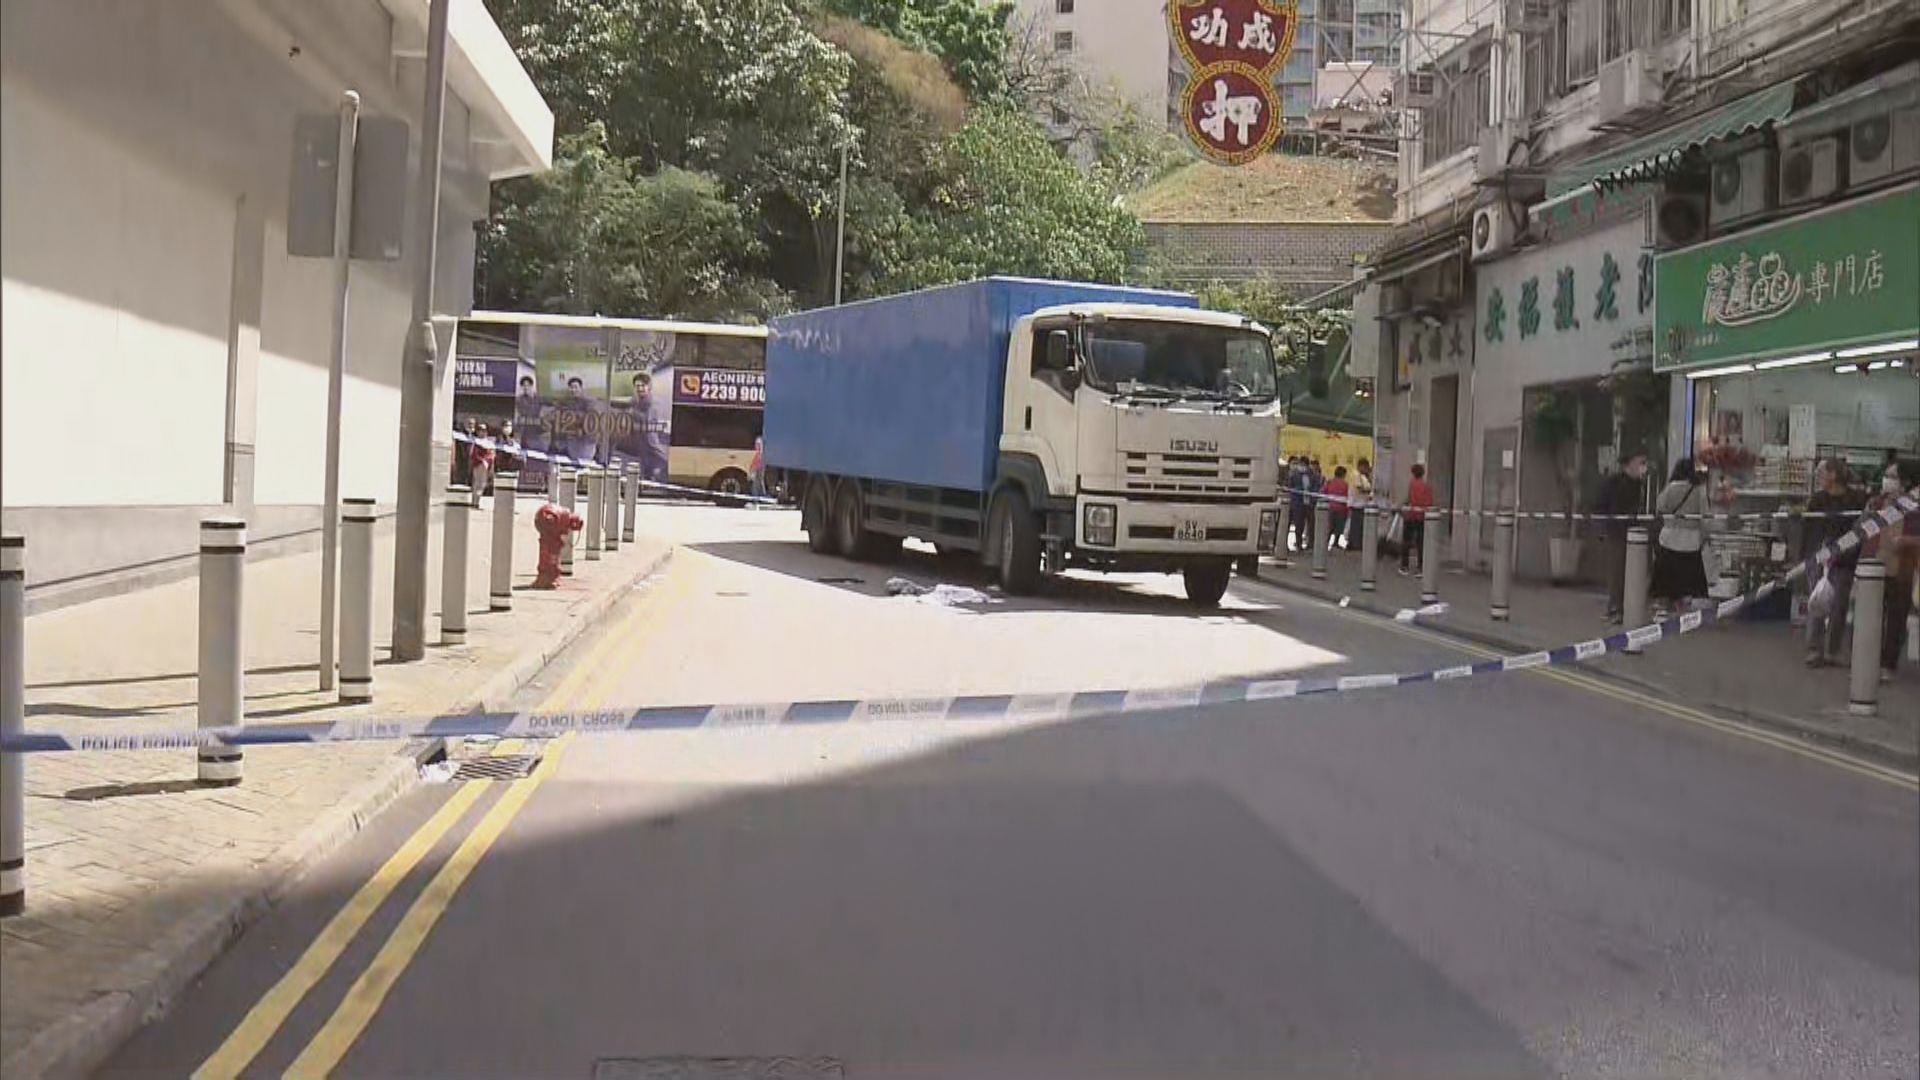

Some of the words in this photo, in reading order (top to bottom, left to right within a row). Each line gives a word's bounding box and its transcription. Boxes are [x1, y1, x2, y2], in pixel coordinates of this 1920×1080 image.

[1200, 80, 1262, 145] 押
[1805, 250, 1884, 304] 專門店
[701, 384, 737, 400] 2239
[542, 409, 632, 436] $12,000
[1170, 438, 1219, 452] ISUZU
[81, 735, 138, 750] POLICE
